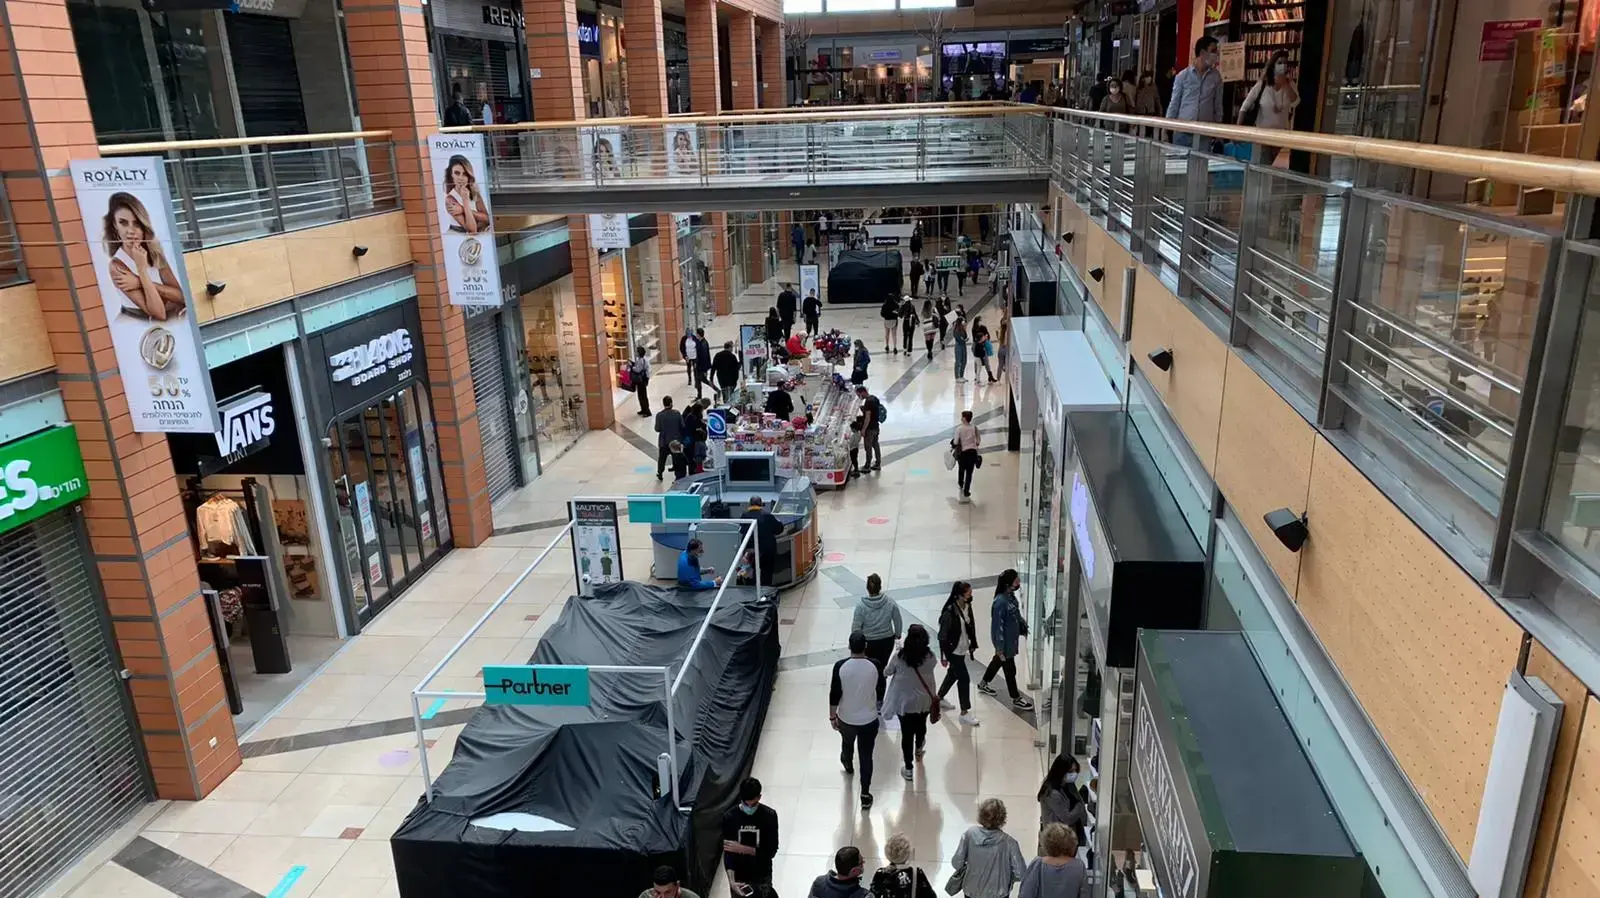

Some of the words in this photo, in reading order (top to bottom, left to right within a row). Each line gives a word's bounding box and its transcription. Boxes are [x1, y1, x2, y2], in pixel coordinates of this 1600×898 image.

[489, 6, 525, 27] REN
[436, 141, 476, 149] ROYALTY
[84, 169, 148, 182] ROYALTY
[352, 365, 386, 386] BOARD
[388, 352, 412, 369] SHOP
[153, 400, 185, 410] הנחה
[215, 393, 275, 457] VANS
[500, 669, 571, 695] Partner
